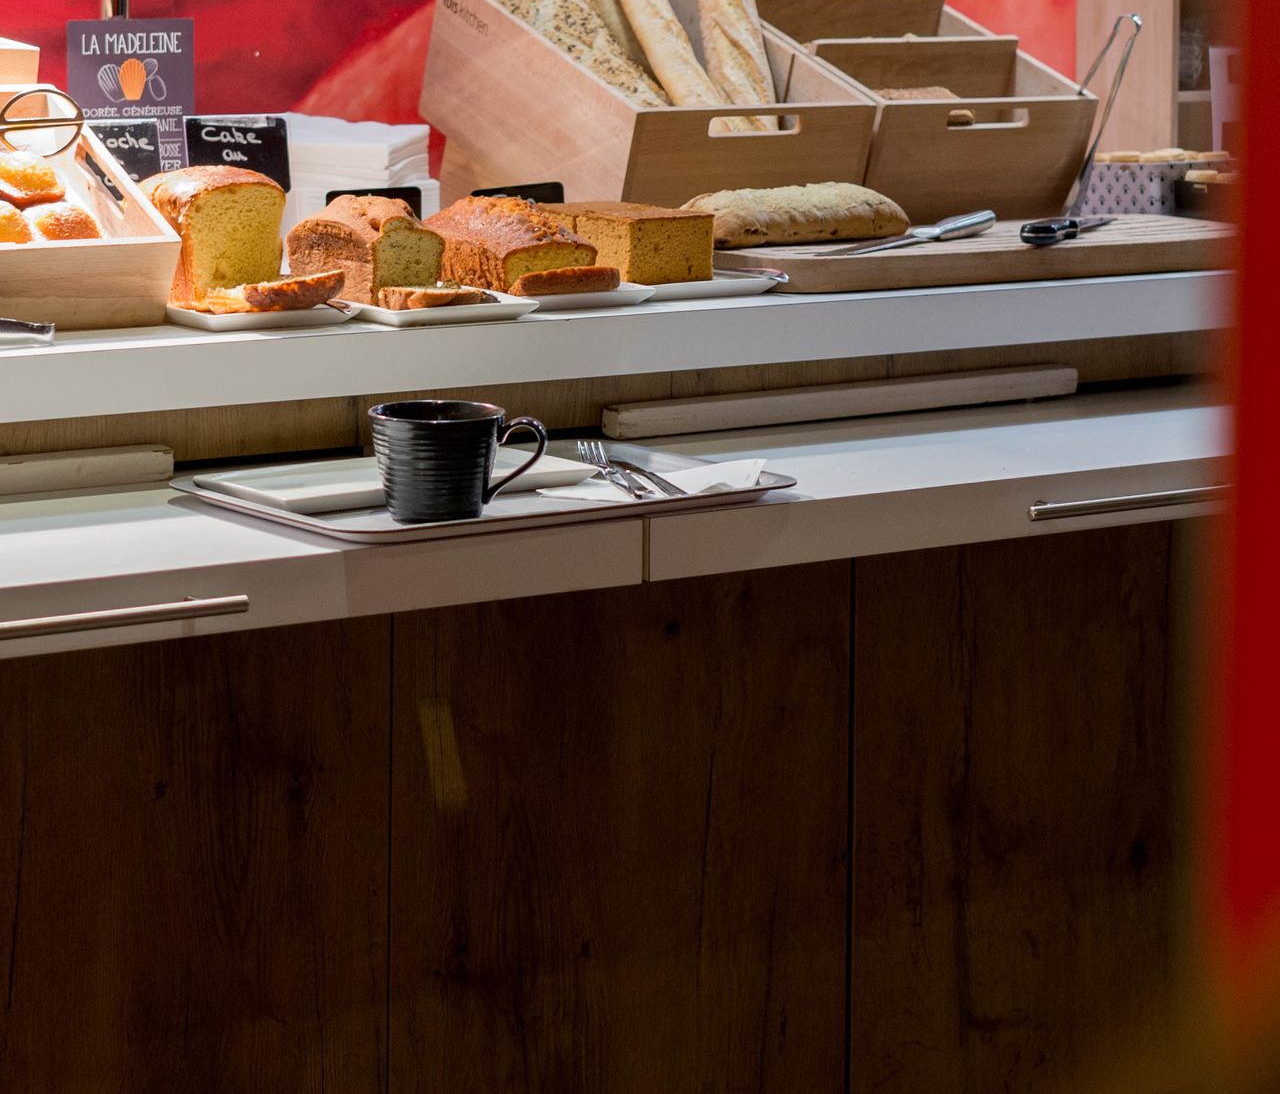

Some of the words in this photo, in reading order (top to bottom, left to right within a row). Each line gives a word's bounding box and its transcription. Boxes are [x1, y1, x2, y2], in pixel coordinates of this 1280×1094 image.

[459, 2, 489, 37] kitchen
[82, 34, 100, 55] LA
[105, 32, 182, 54] MADELEINE
[122, 105, 183, 117] GÉNÉREUSE
[201, 126, 262, 145] Cake
[222, 149, 248, 162] au
